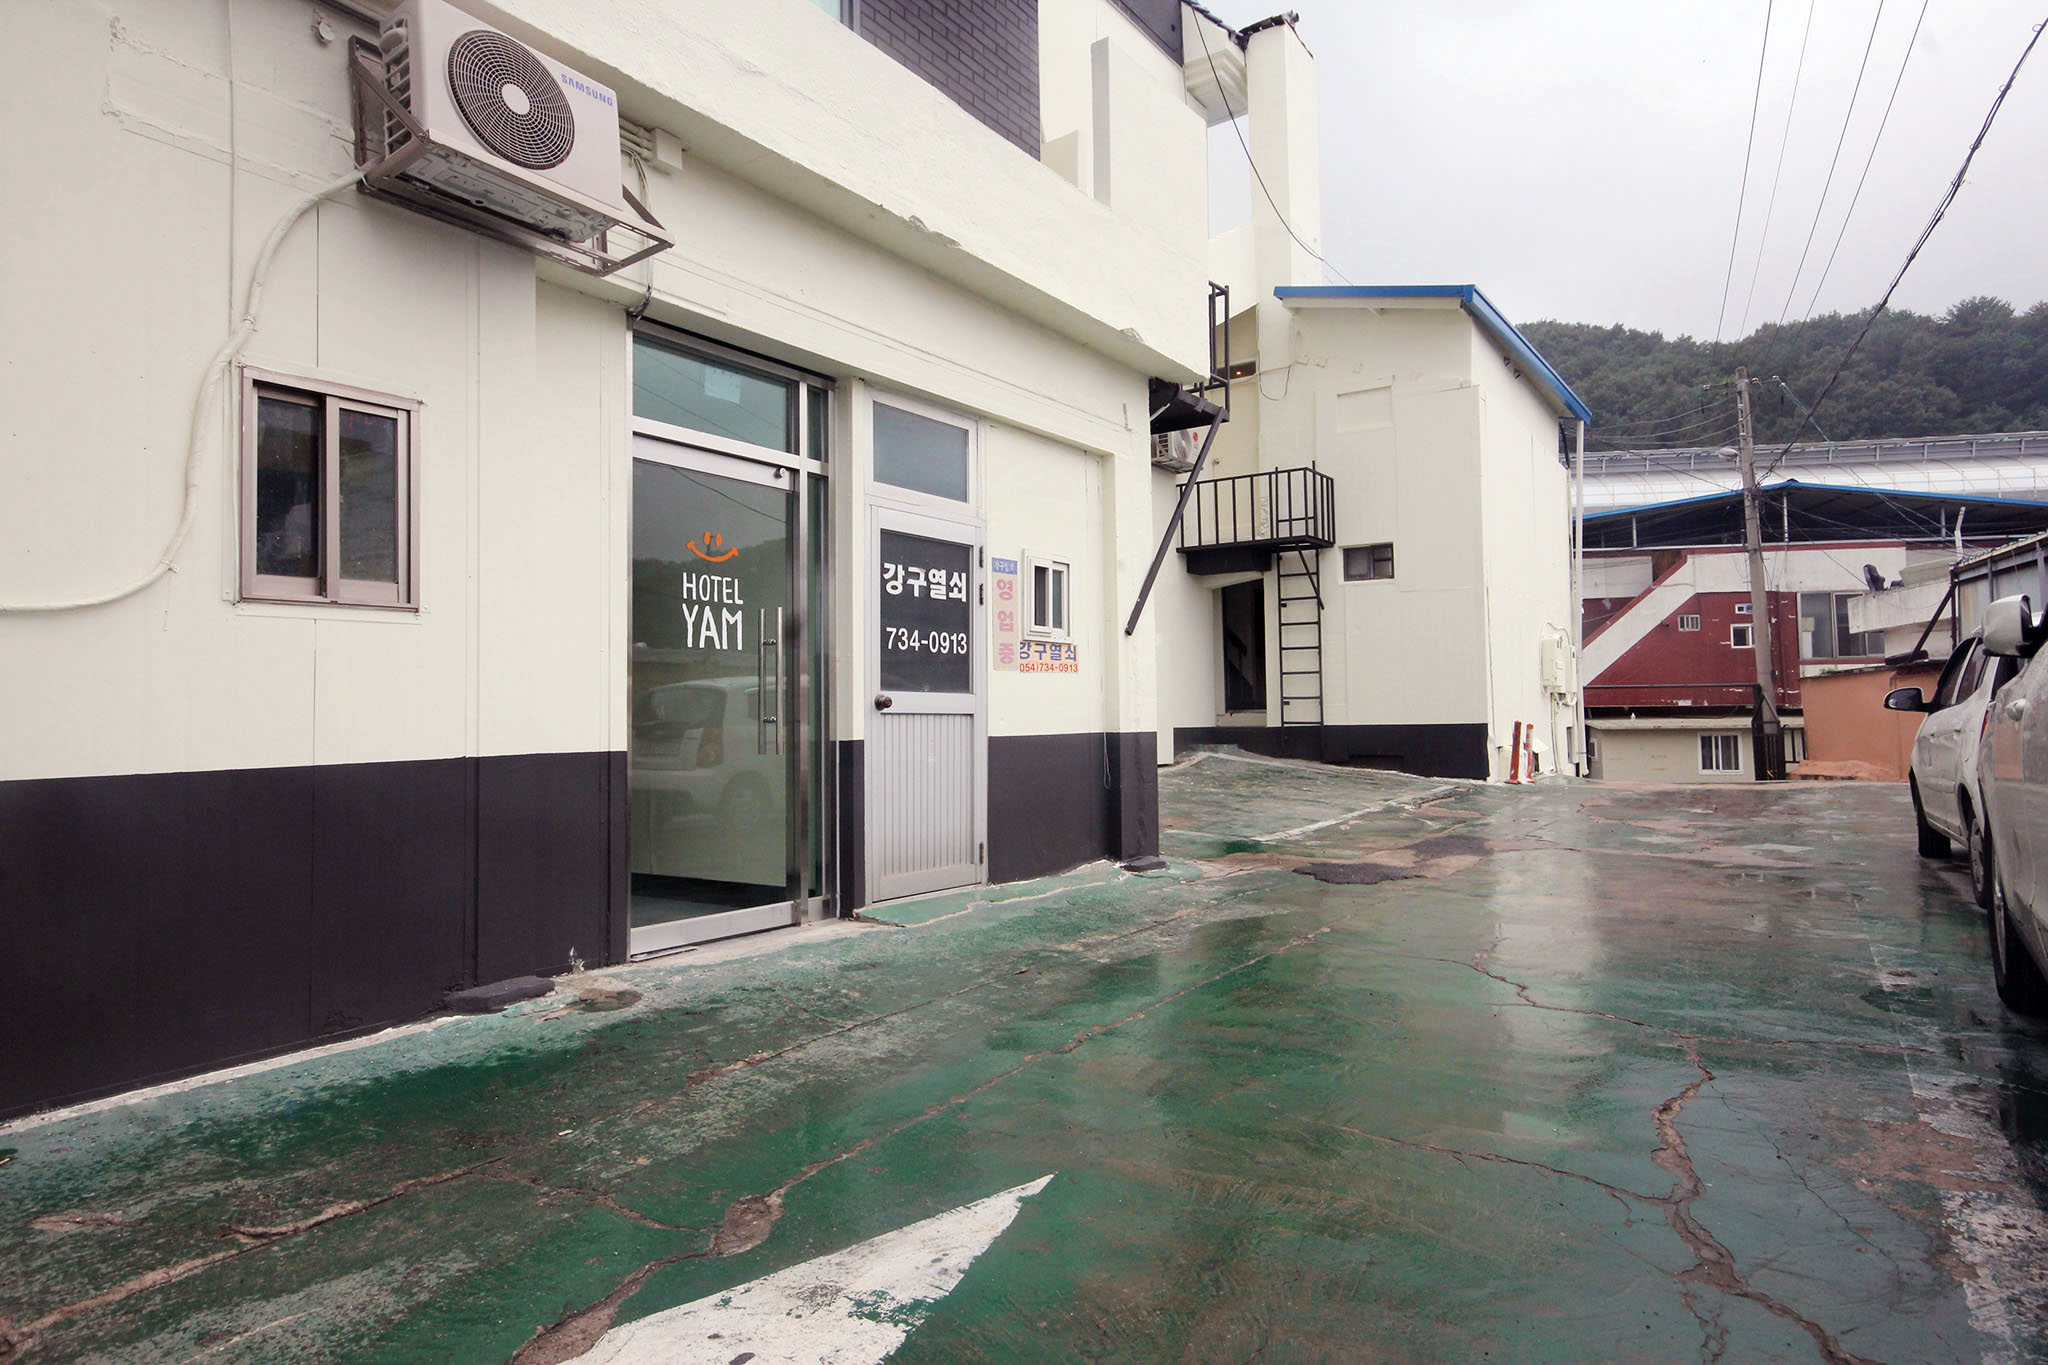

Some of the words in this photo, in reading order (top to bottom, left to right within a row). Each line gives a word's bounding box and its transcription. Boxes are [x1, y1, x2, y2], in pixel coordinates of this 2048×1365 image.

[561, 73, 613, 106] SAMSUNG
[682, 572, 744, 604] HOTEL
[883, 562, 967, 602] 강구열쇠
[682, 603, 743, 650] YAM
[886, 627, 967, 654] 734-0913
[1019, 641, 1077, 662] 강구열쇠
